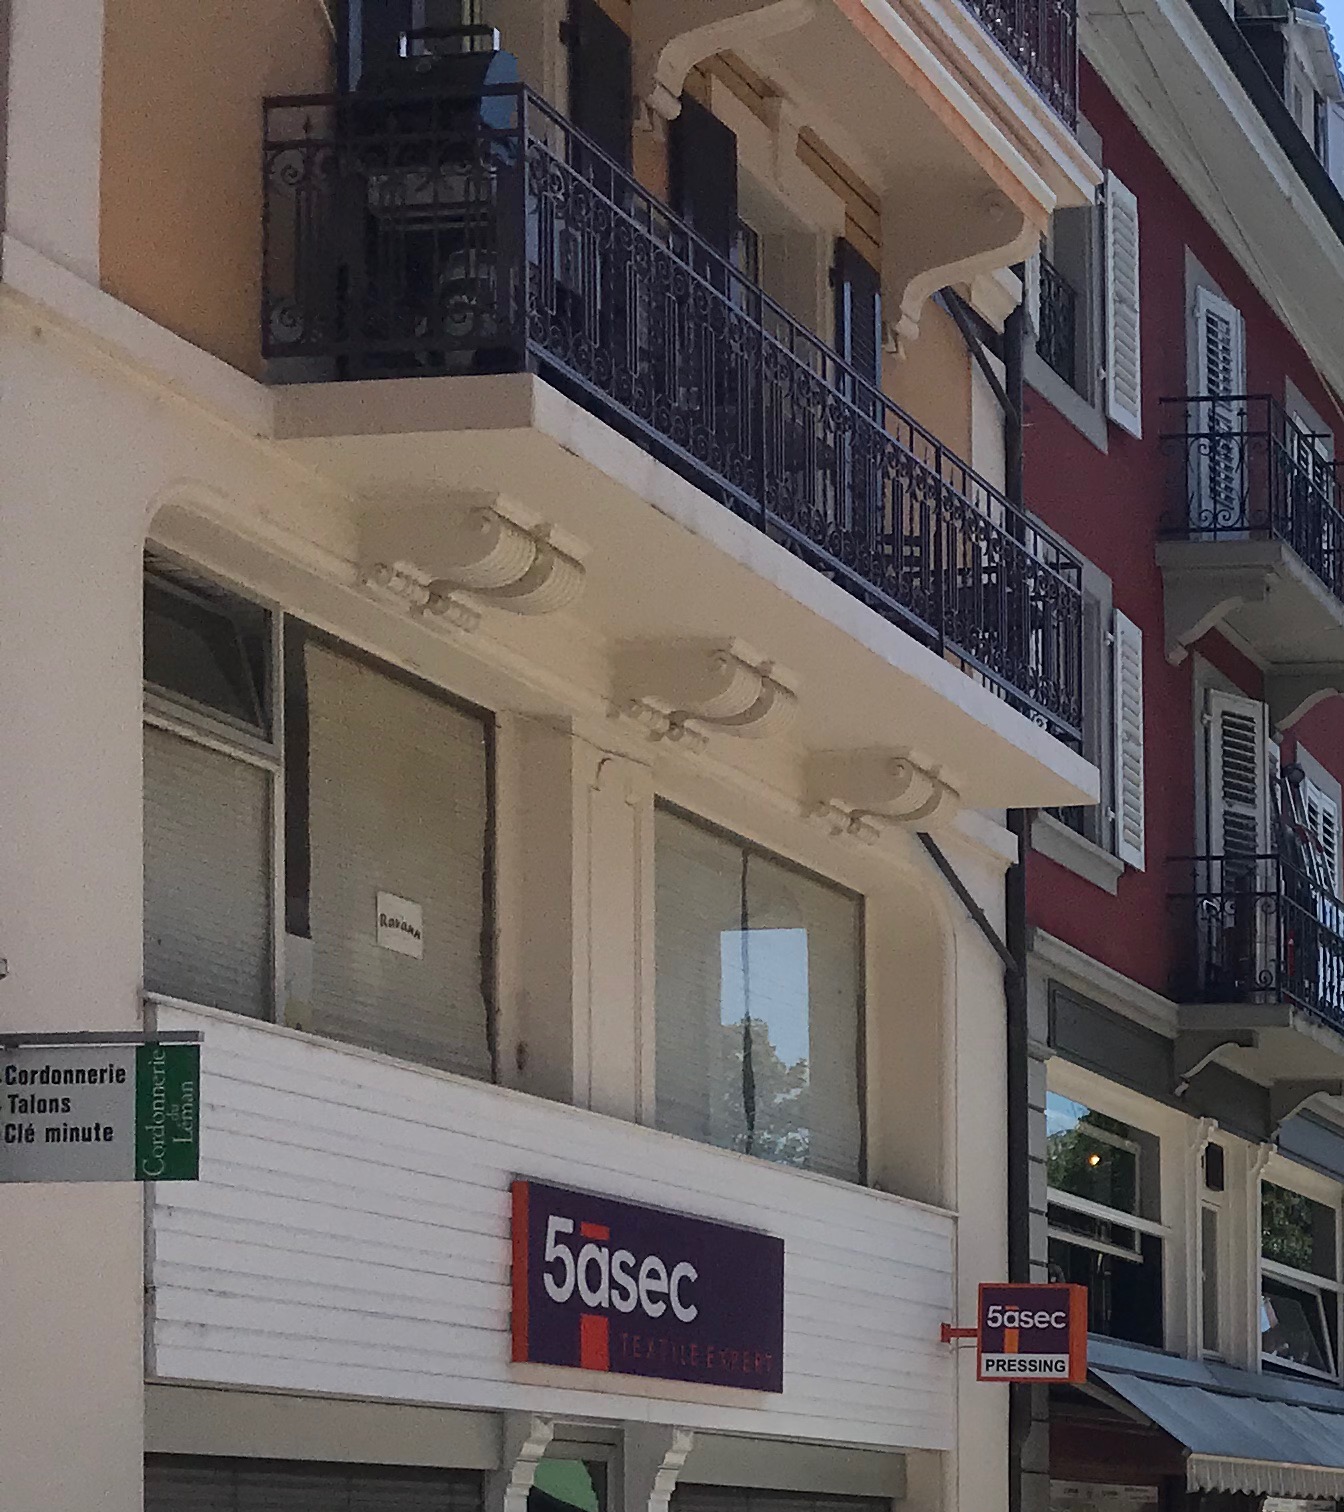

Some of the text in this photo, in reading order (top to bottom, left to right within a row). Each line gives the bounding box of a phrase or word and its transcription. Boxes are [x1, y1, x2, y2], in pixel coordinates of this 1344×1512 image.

[5, 1064, 127, 1086] Cordonnerie
[7, 1093, 72, 1114] Talons
[143, 1048, 166, 1177] Cordonnerie
[172, 1081, 194, 1144] Léman
[4, 1122, 114, 1144] Clé minute
[985, 1359, 1066, 1373] PRESSING
